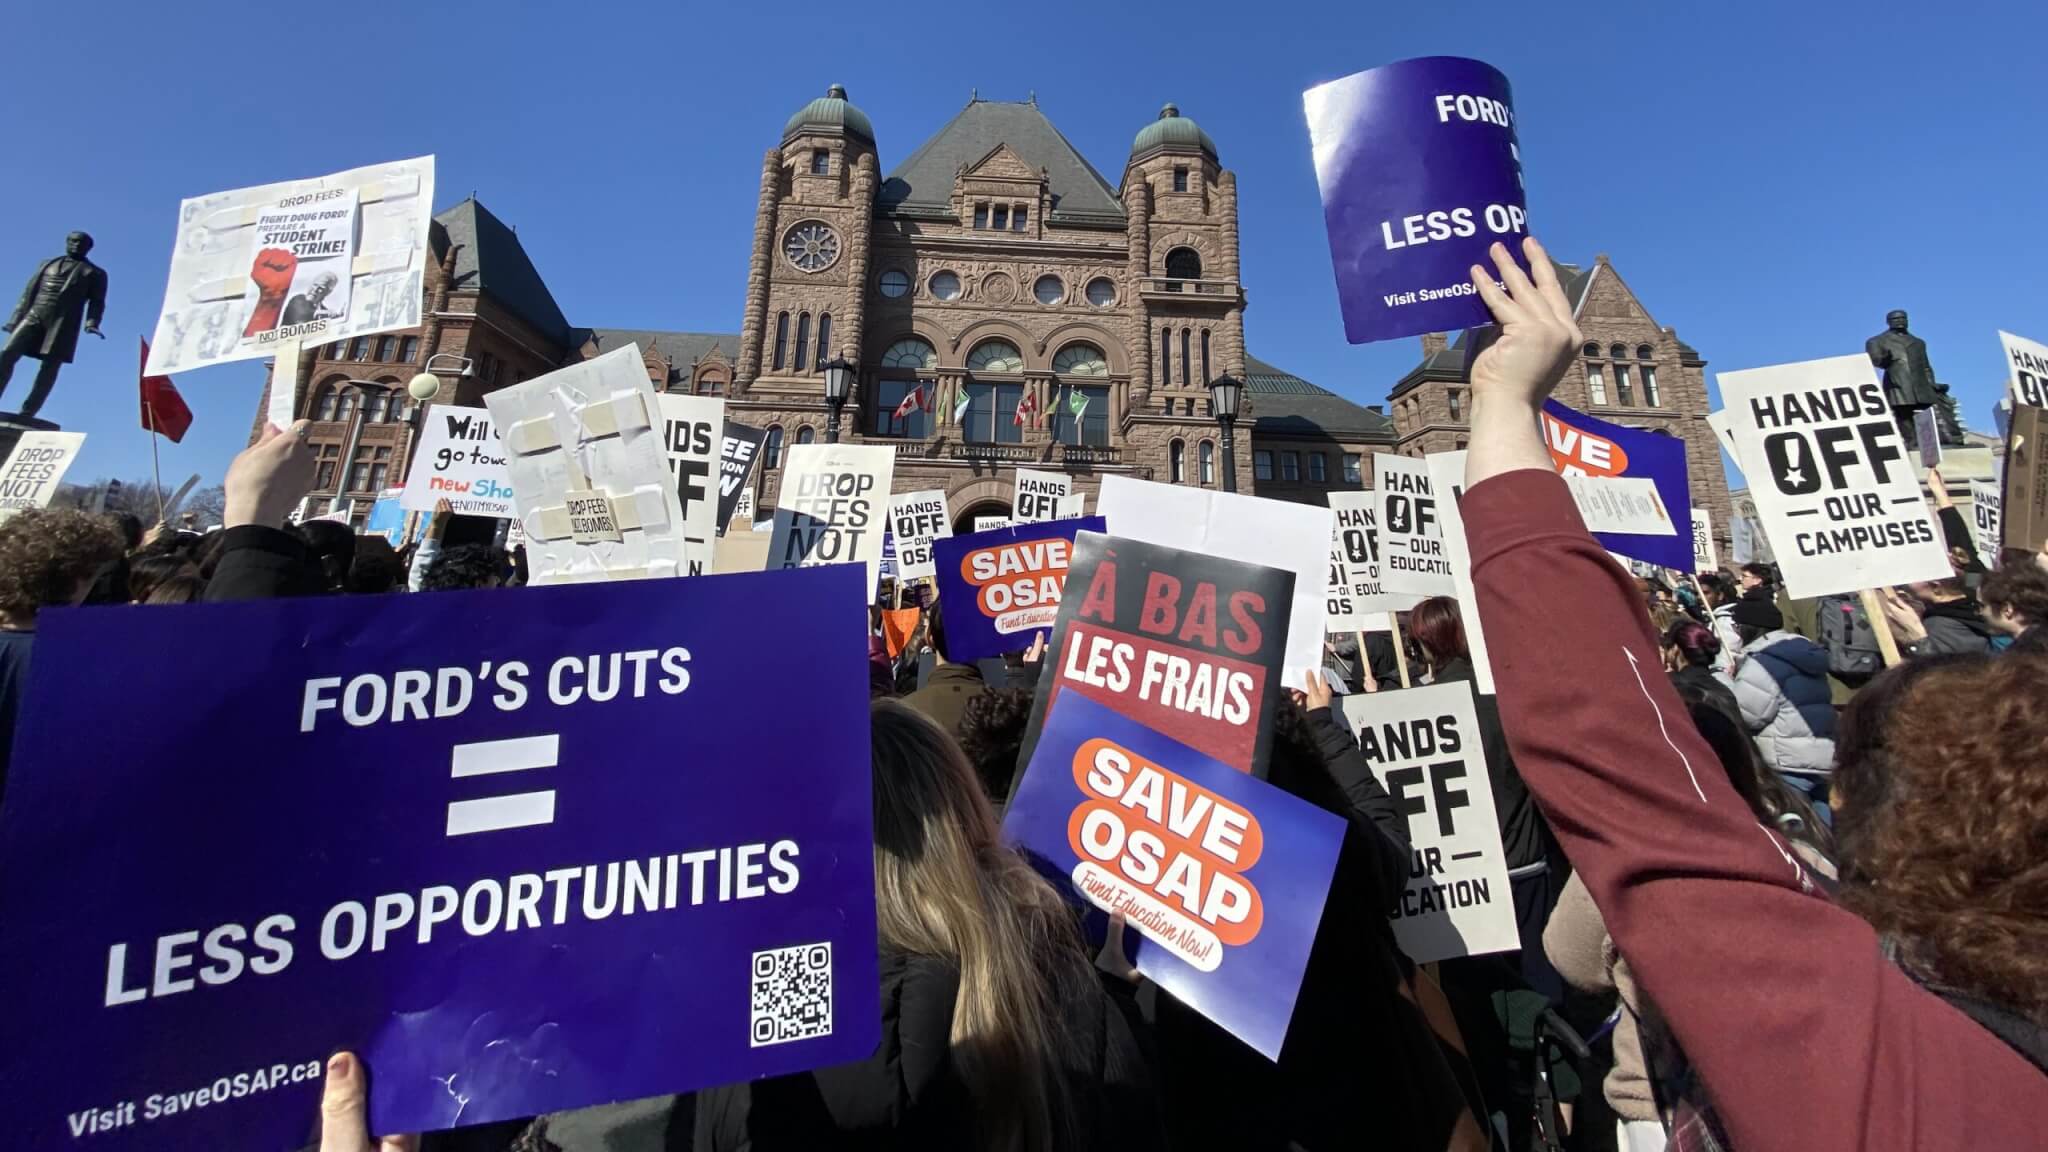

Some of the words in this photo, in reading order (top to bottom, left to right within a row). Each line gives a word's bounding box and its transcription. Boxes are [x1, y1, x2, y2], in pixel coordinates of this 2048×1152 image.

[1435, 95, 1513, 127] FORD'
[280, 194, 312, 208] DROP
[315, 189, 344, 201] FEES
[257, 223, 298, 232] PREPARE
[299, 222, 306, 230] A
[260, 215, 289, 224] FIGHT
[290, 212, 317, 222] DOUG
[318, 209, 348, 220] FORD!
[1381, 207, 1476, 250] LESS
[262, 228, 327, 244] STUDENT
[292, 240, 346, 255] STRIKE!
[1384, 291, 1416, 307] Visit
[259, 332, 279, 343] NOT
[280, 320, 326, 339] BOMBS
[1751, 384, 1886, 429] HANDS
[446, 415, 488, 440] Will
[1540, 412, 1611, 470] VE
[17, 448, 65, 462] DROP
[434, 448, 464, 471] go
[1764, 421, 1900, 496] OFF
[6, 463, 56, 479] FEES
[1384, 471, 1434, 496] HAN
[0, 480, 48, 498] NOT
[429, 477, 470, 492] new
[797, 473, 874, 497] DROP
[1019, 478, 1065, 496] HANDS
[567, 499, 585, 515] DROP
[587, 498, 607, 514] FEES
[792, 499, 870, 527] FEES
[895, 501, 942, 516] HANDS
[1386, 494, 1443, 538] OF
[1825, 493, 1886, 522] OUR
[582, 516, 614, 532] BOMBS
[897, 513, 944, 538] OFF
[785, 528, 867, 562] NOT
[1411, 538, 1441, 556] OUR
[1796, 519, 1934, 557] CAMPUSES
[972, 542, 1068, 581] SAVE
[985, 576, 1067, 612] OSA
[1079, 550, 1118, 623] À
[1138, 571, 1266, 655] BAS
[1001, 615, 1020, 630] Fund
[300, 659, 529, 732] FORD'S
[548, 647, 692, 708] CUTS
[1064, 631, 1135, 693] LES
[1139, 650, 1254, 726] FRAIS
[1087, 747, 1249, 864] SAVE
[1080, 808, 1251, 926] OSAP
[105, 913, 294, 1007] LESS
[320, 839, 800, 960] OPPORTUNITIES
[1079, 870, 1116, 902] Fund
[1111, 889, 1177, 940] Education
[1176, 929, 1214, 962] Now!
[68, 1100, 136, 1137] Visit
[144, 1060, 321, 1119] SaveOSAP.ca
